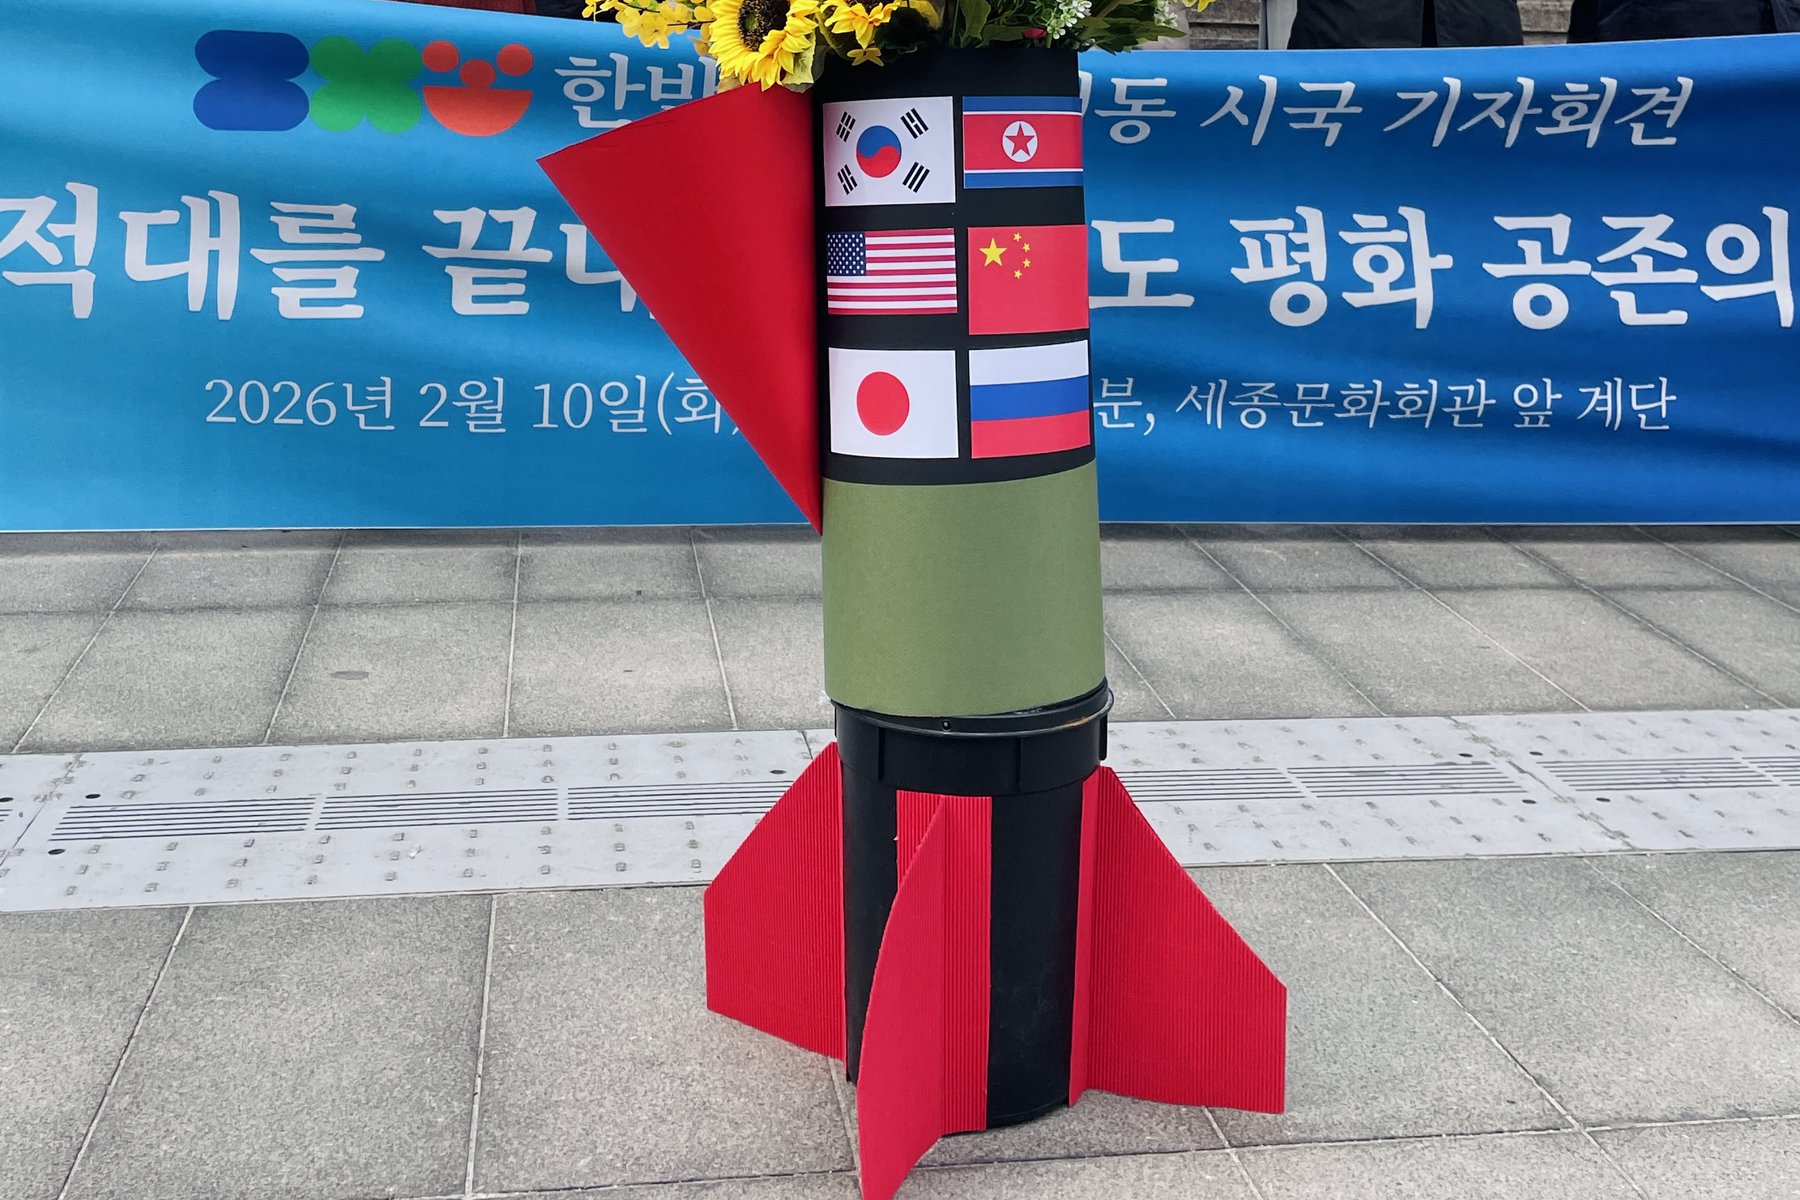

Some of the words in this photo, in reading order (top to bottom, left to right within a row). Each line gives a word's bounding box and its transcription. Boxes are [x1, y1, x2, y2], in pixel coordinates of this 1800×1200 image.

[1079, 70, 1177, 145] 동
[1200, 76, 1363, 148] 시국
[1382, 75, 1695, 149] 기자회견
[0, 181, 386, 321] 적대를
[1229, 205, 1453, 330] 평화
[1481, 205, 1797, 330] 공존의
[204, 376, 396, 432] 2026년
[418, 376, 508, 435] 2월
[532, 372, 739, 436] 10일(화
[1175, 377, 1497, 432] 세종문화회관
[1512, 377, 1563, 431] 앞
[1576, 377, 1679, 432] 계단
